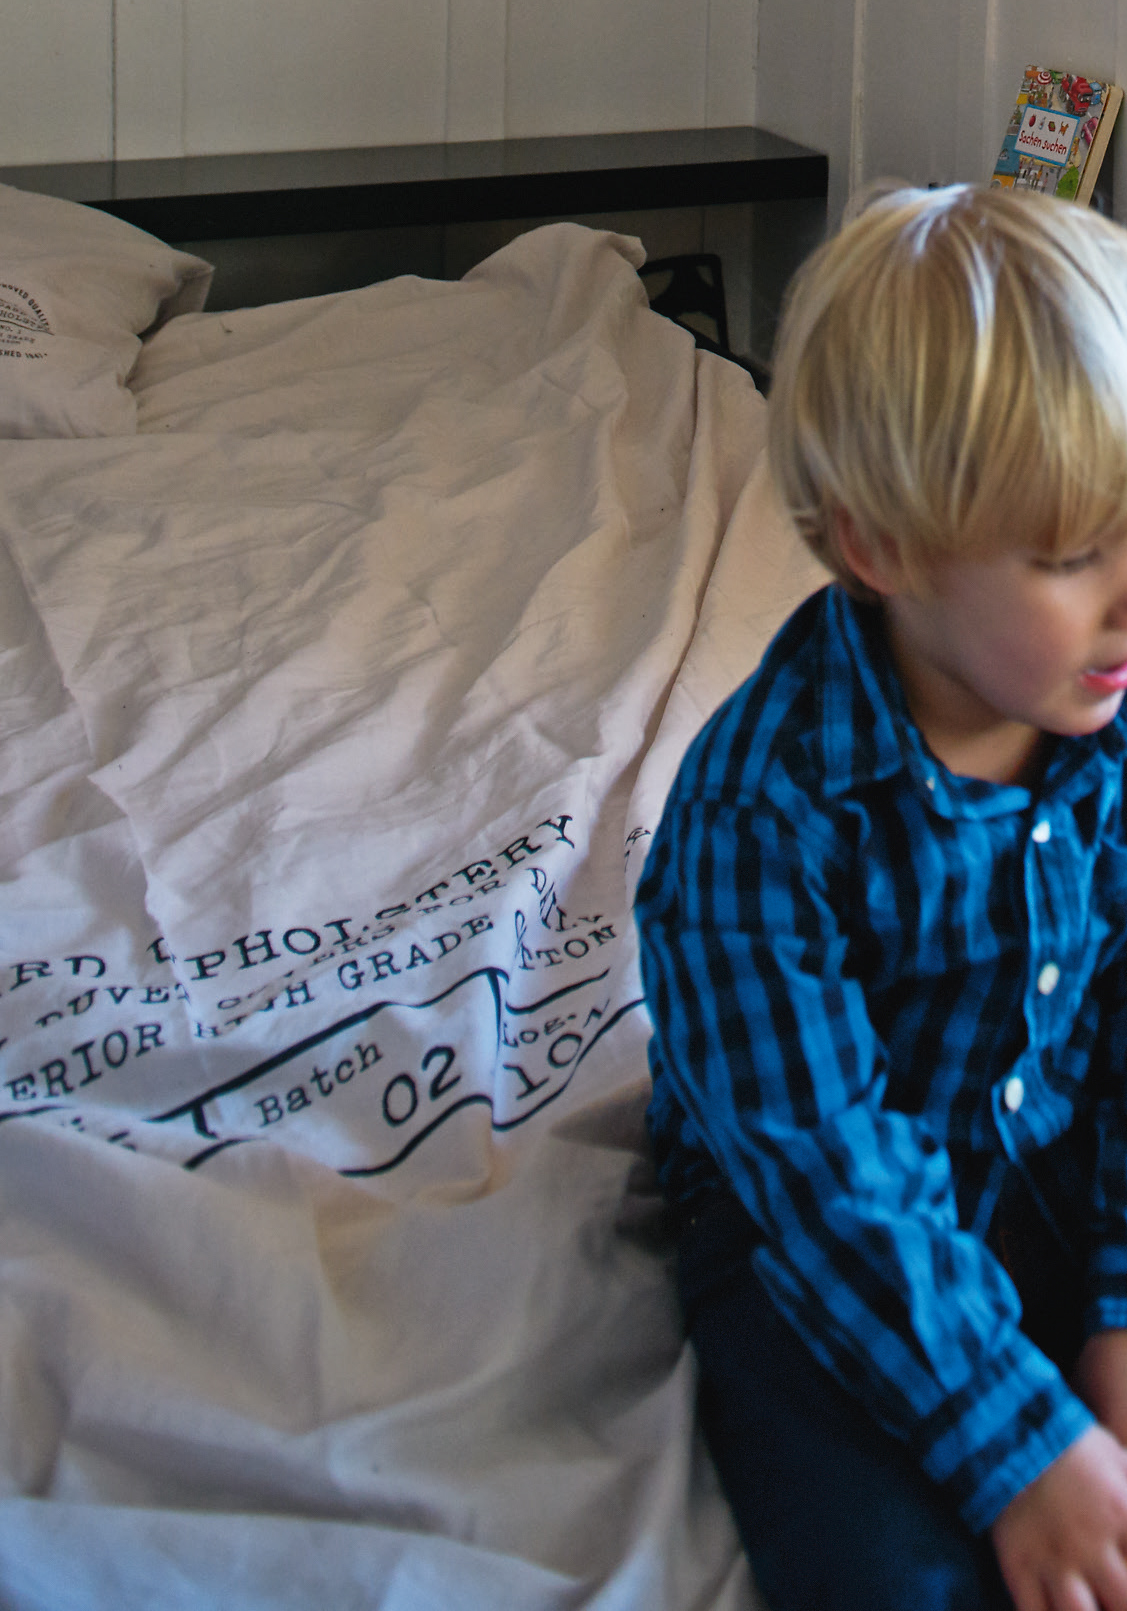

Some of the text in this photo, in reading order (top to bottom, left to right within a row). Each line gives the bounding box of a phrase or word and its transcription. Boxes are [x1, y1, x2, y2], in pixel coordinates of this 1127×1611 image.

[1019, 130, 1067, 155] Sachen suchen
[337, 914, 493, 991] GRADE
[258, 1040, 383, 1127] Batch
[382, 1045, 461, 1127] 02
[502, 1033, 583, 1100] 10
